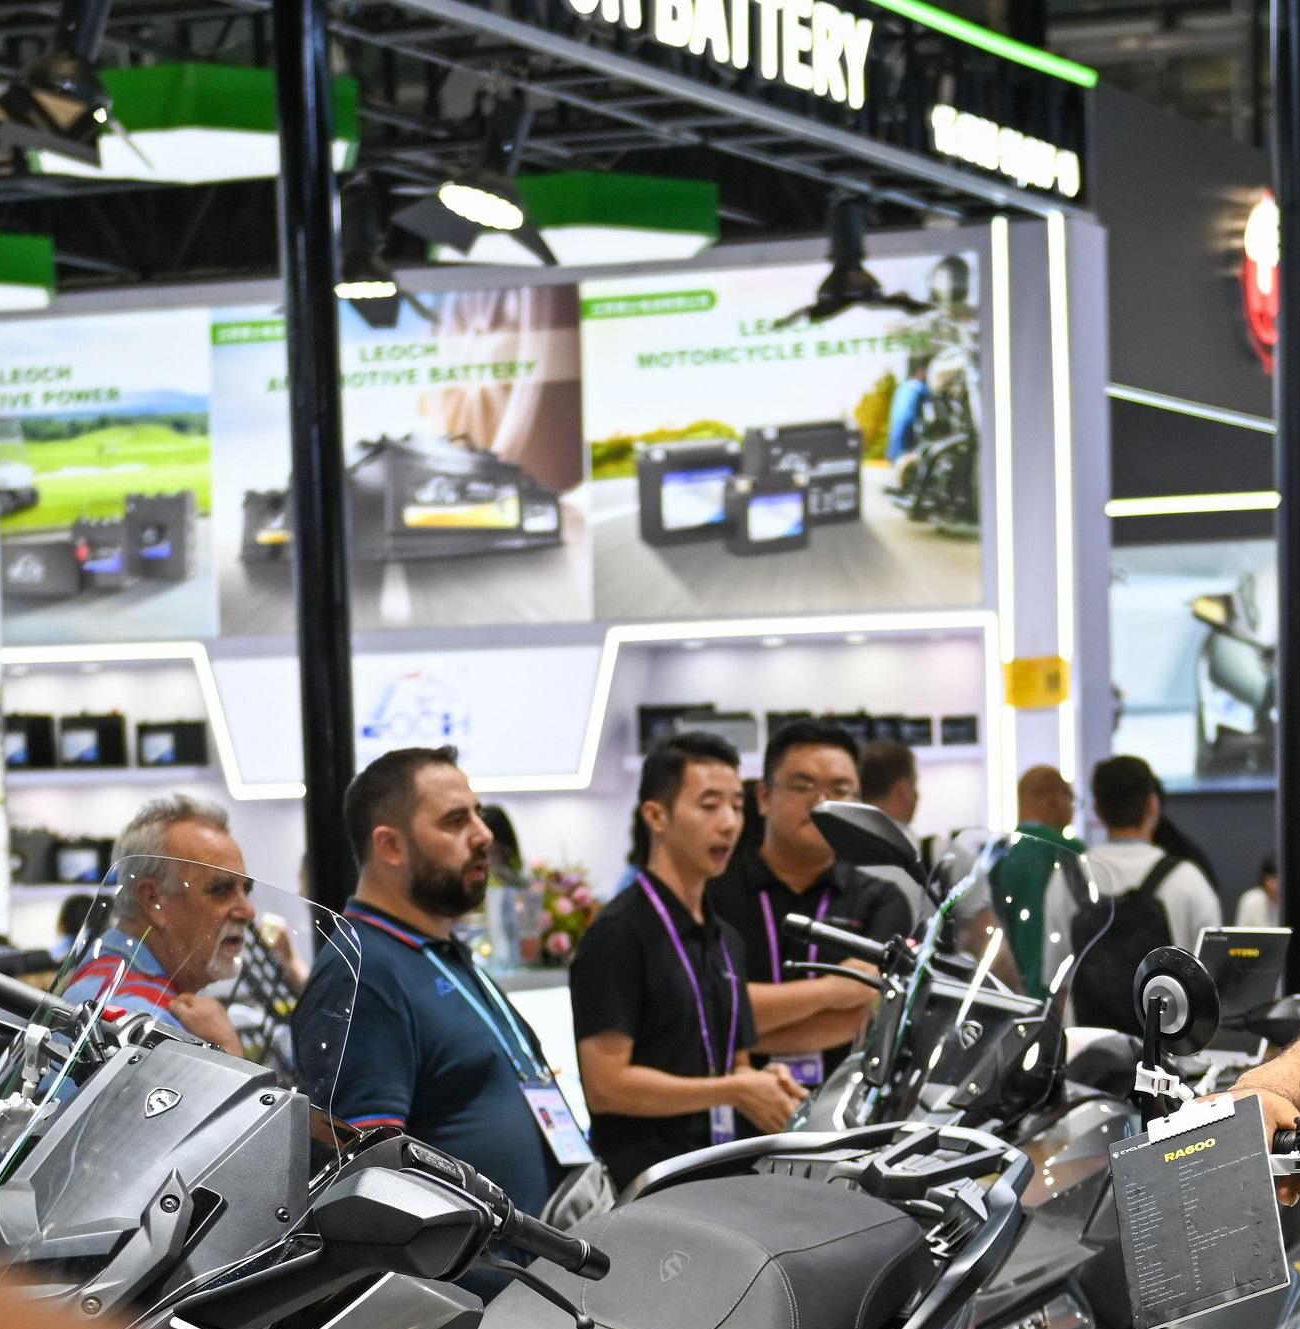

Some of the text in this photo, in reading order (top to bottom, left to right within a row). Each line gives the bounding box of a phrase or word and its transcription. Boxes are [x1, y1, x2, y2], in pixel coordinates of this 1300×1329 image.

[359, 341, 439, 364] LEOCH
[636, 342, 803, 370] MOTORCYCLE
[428, 359, 538, 384] BATTERY
[42, 384, 121, 406] POWER
[1120, 1141, 1151, 1156] CYCLON
[1163, 1137, 1217, 1163] RA600
